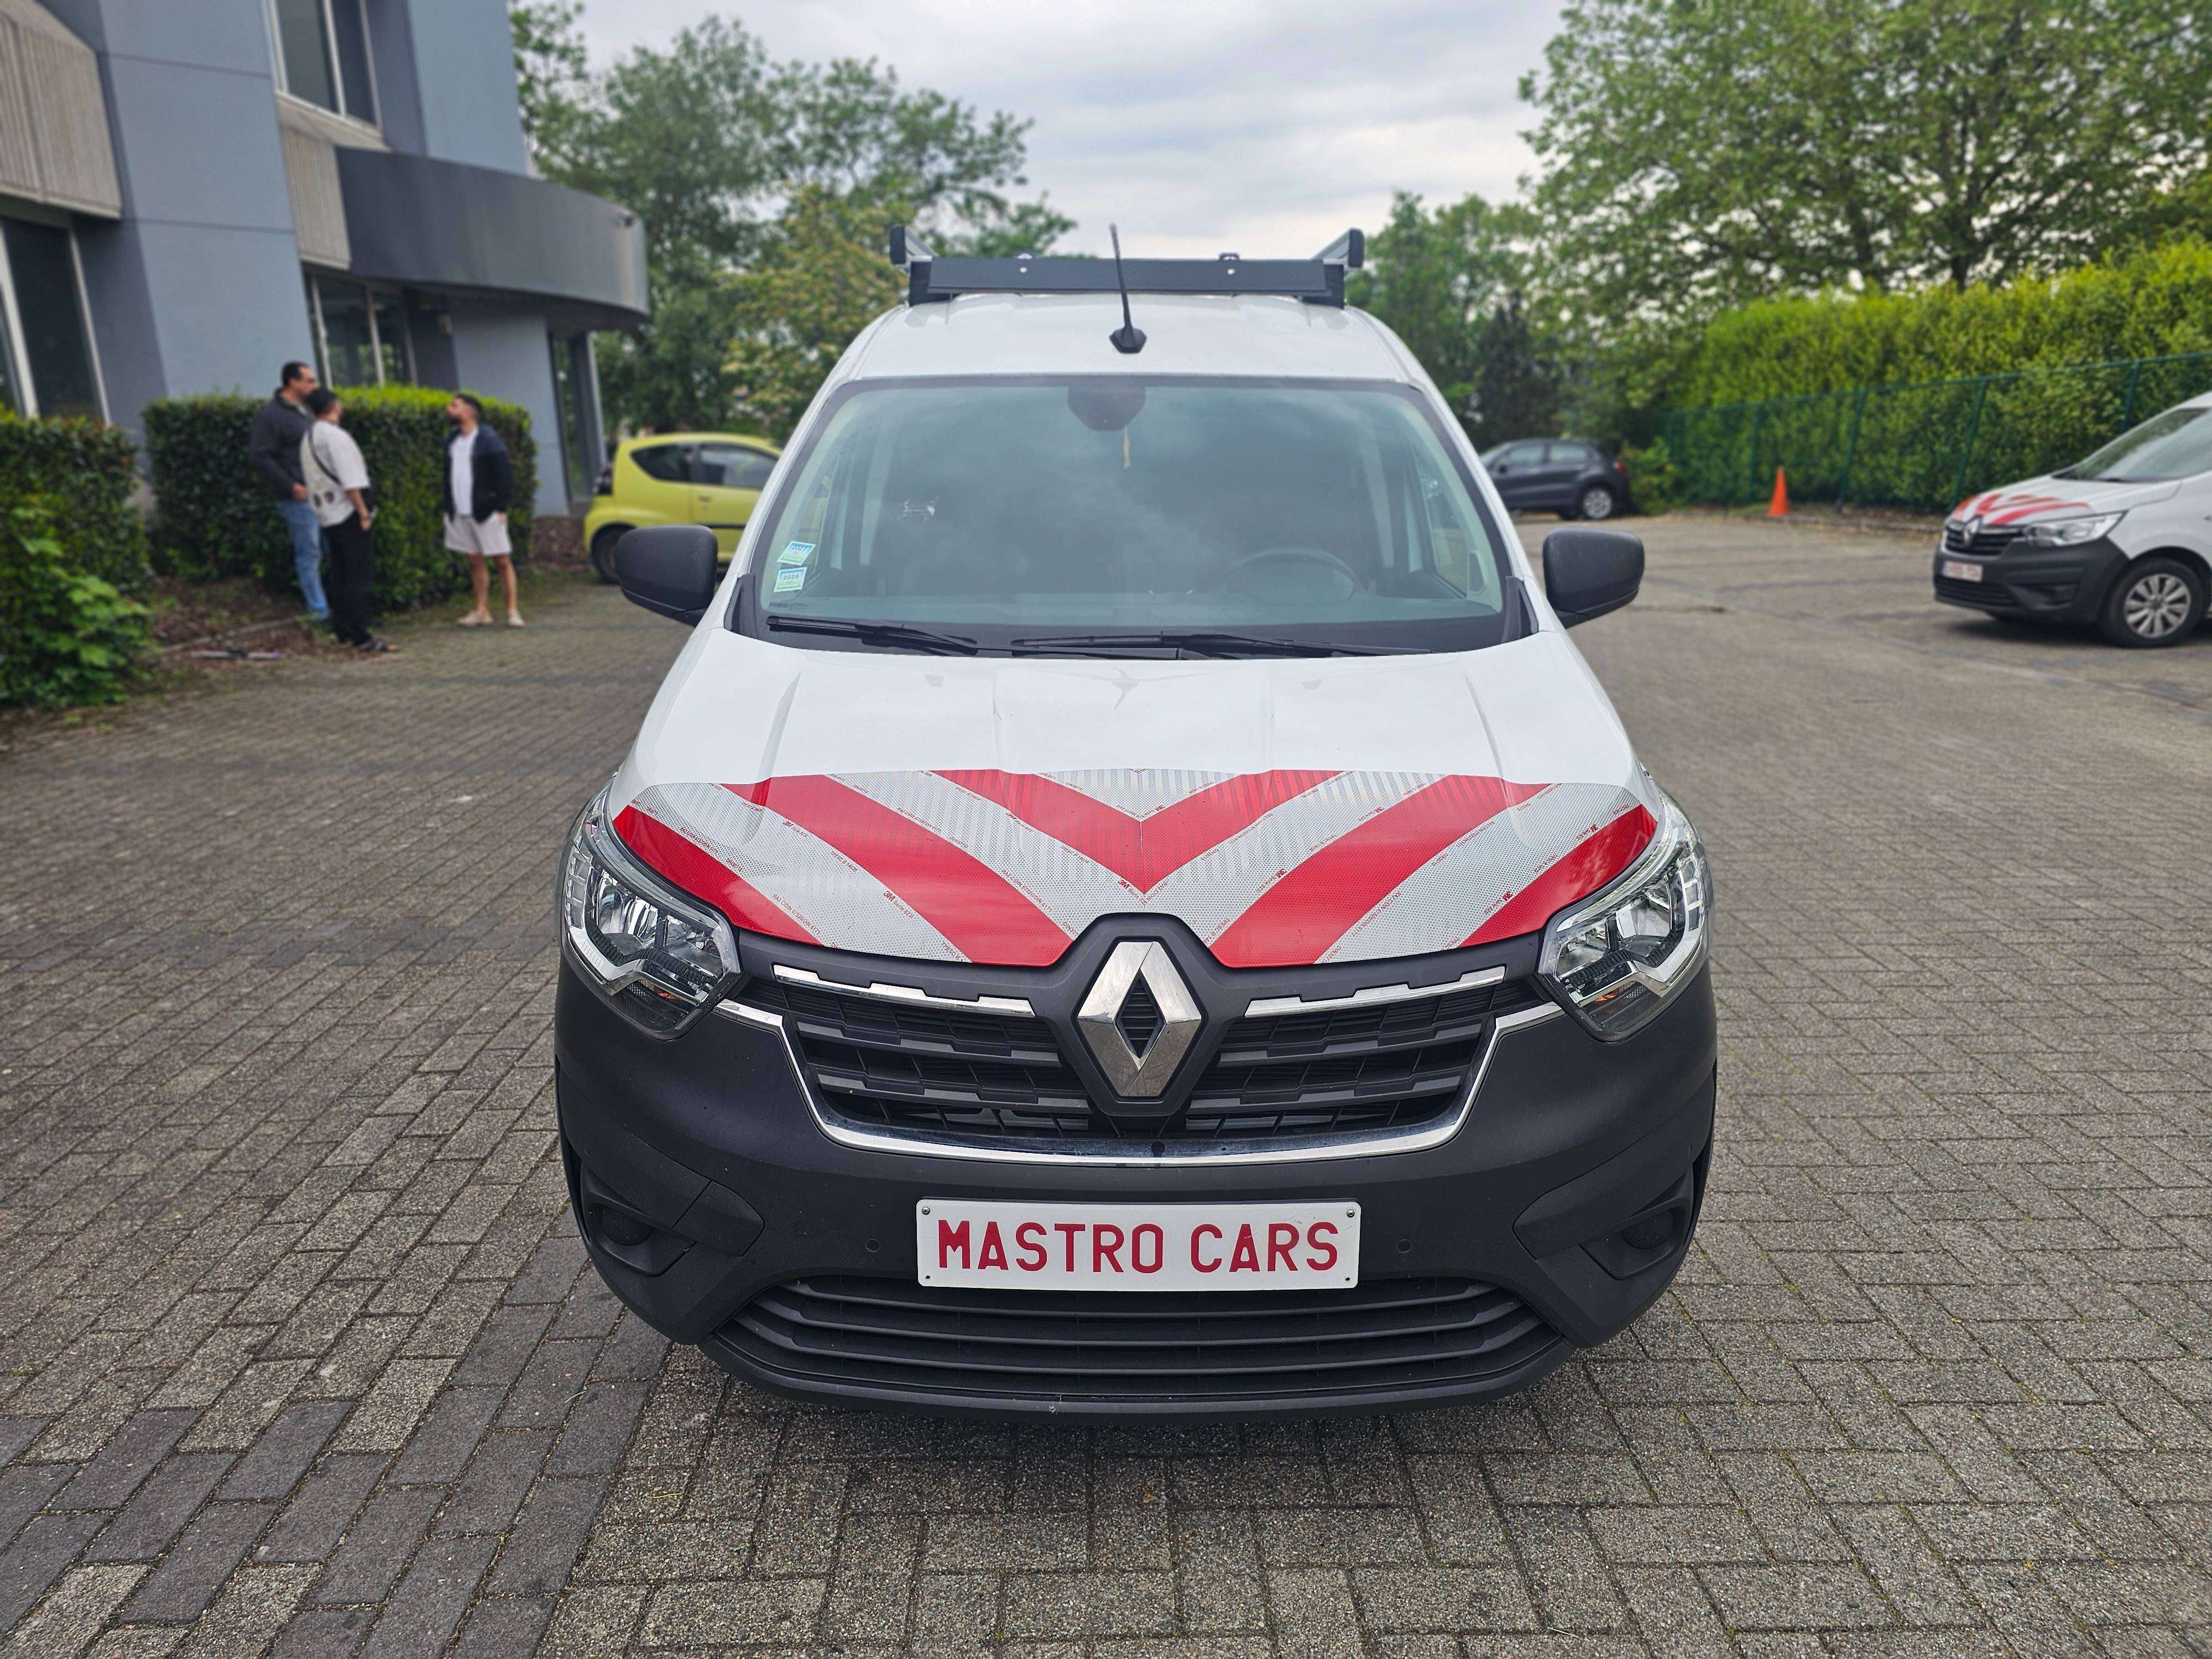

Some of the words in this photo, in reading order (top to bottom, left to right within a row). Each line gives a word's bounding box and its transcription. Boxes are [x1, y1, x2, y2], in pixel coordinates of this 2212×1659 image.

[884, 890, 896, 902] 3M
[938, 1219, 1164, 1274] MASTRO
[1191, 1221, 1339, 1273] CARS
